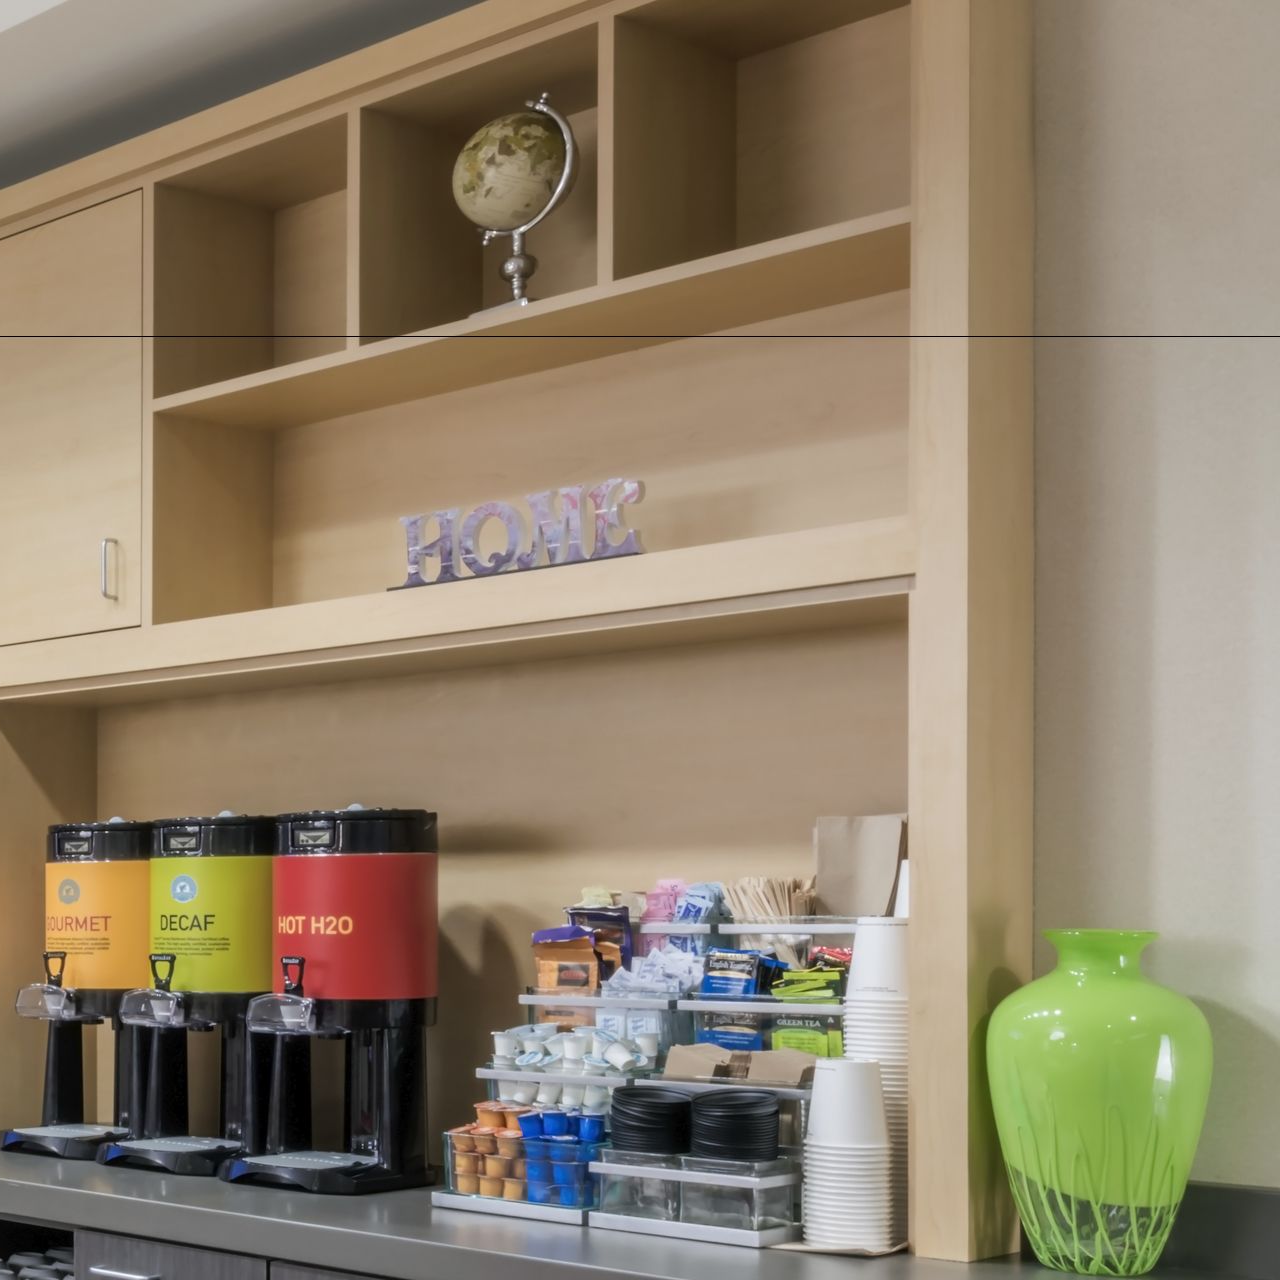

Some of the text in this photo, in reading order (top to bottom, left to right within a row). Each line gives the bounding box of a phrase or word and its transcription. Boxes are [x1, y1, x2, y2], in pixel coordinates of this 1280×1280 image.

[399, 477, 646, 588] HOME
[160, 914, 216, 932] DECAF
[278, 915, 354, 935] HOT H2O
[776, 1018, 803, 1026] GREEN
[804, 1019, 822, 1027] TEA
